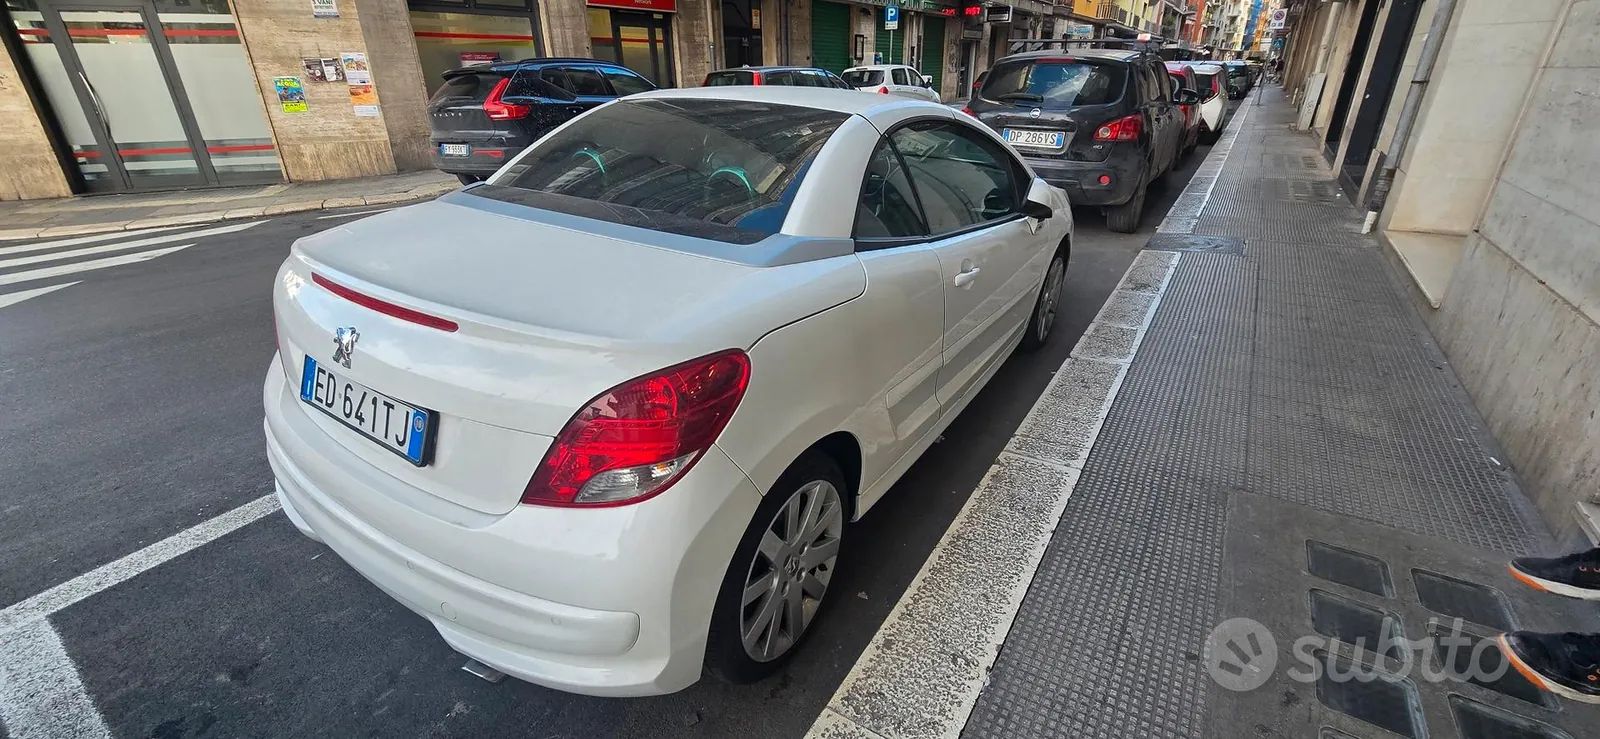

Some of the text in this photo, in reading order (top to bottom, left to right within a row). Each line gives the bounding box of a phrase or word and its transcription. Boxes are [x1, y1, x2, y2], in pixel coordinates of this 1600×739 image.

[887, 7, 896, 21] P
[1010, 131, 1057, 144] DP 286VS
[314, 366, 410, 447] ED 641TJ
